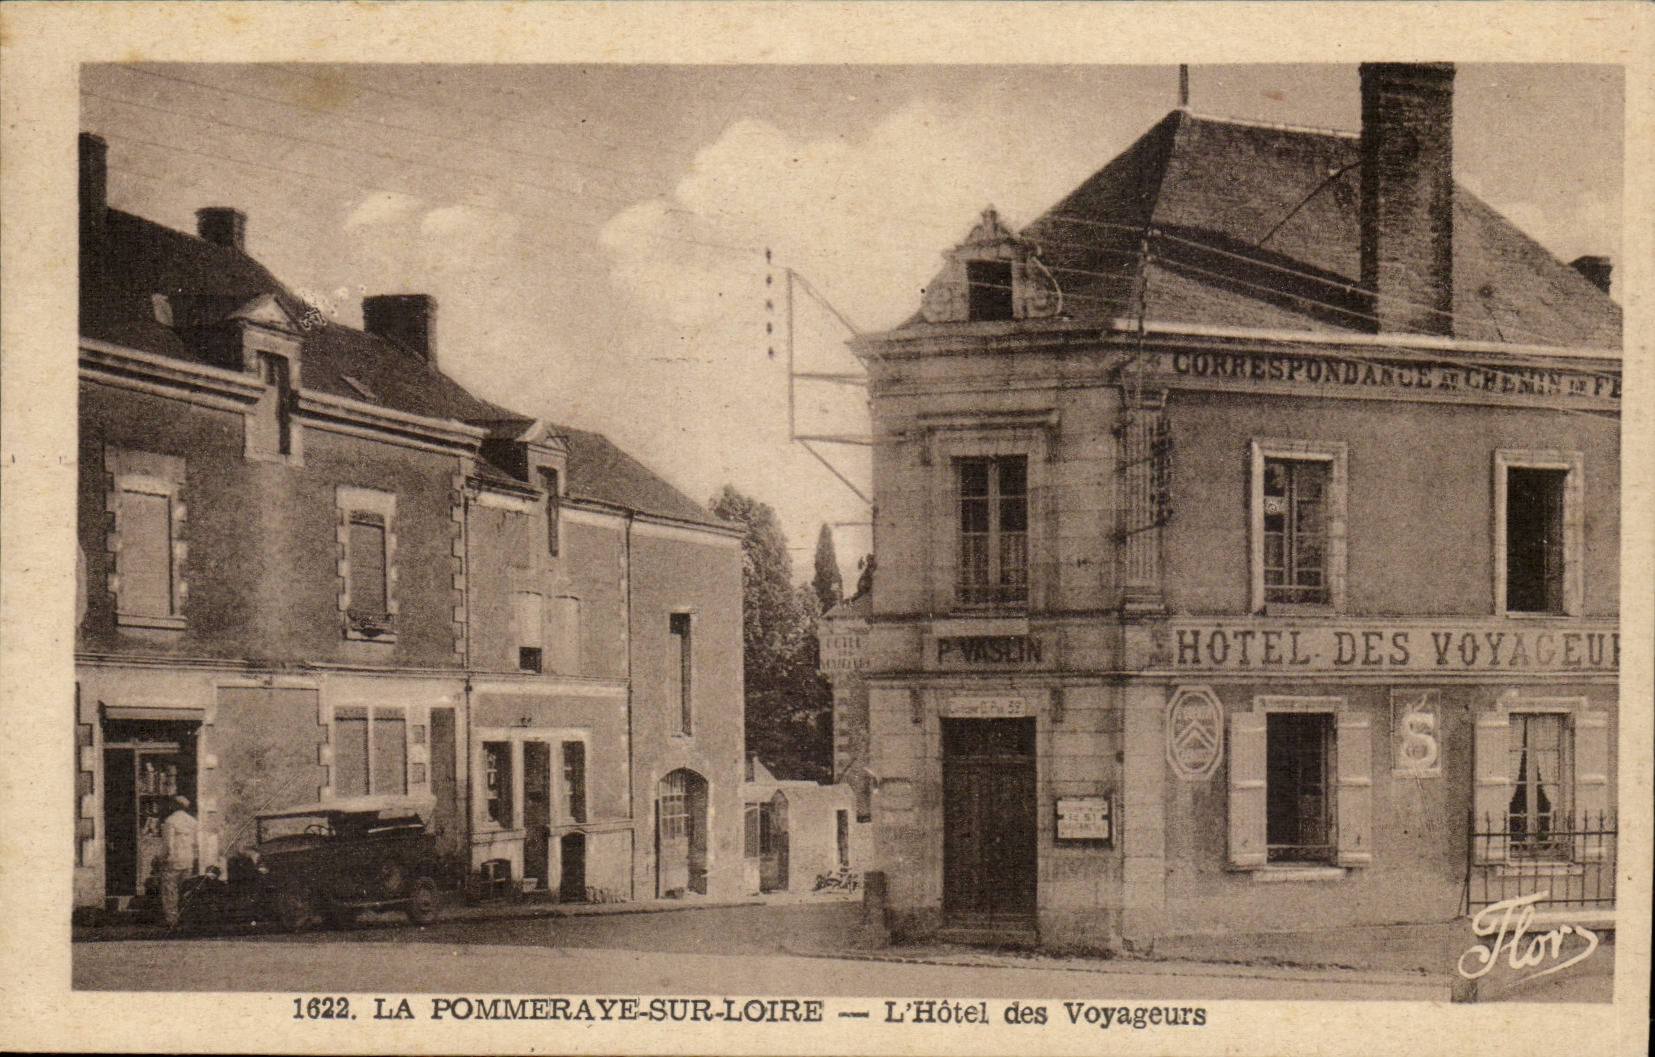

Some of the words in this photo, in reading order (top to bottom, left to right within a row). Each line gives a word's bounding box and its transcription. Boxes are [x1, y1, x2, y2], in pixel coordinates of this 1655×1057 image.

[1173, 352, 1432, 388] CORRESPONDANCE
[1465, 366, 1562, 395] CHEMIN
[1334, 631, 1410, 666] DES
